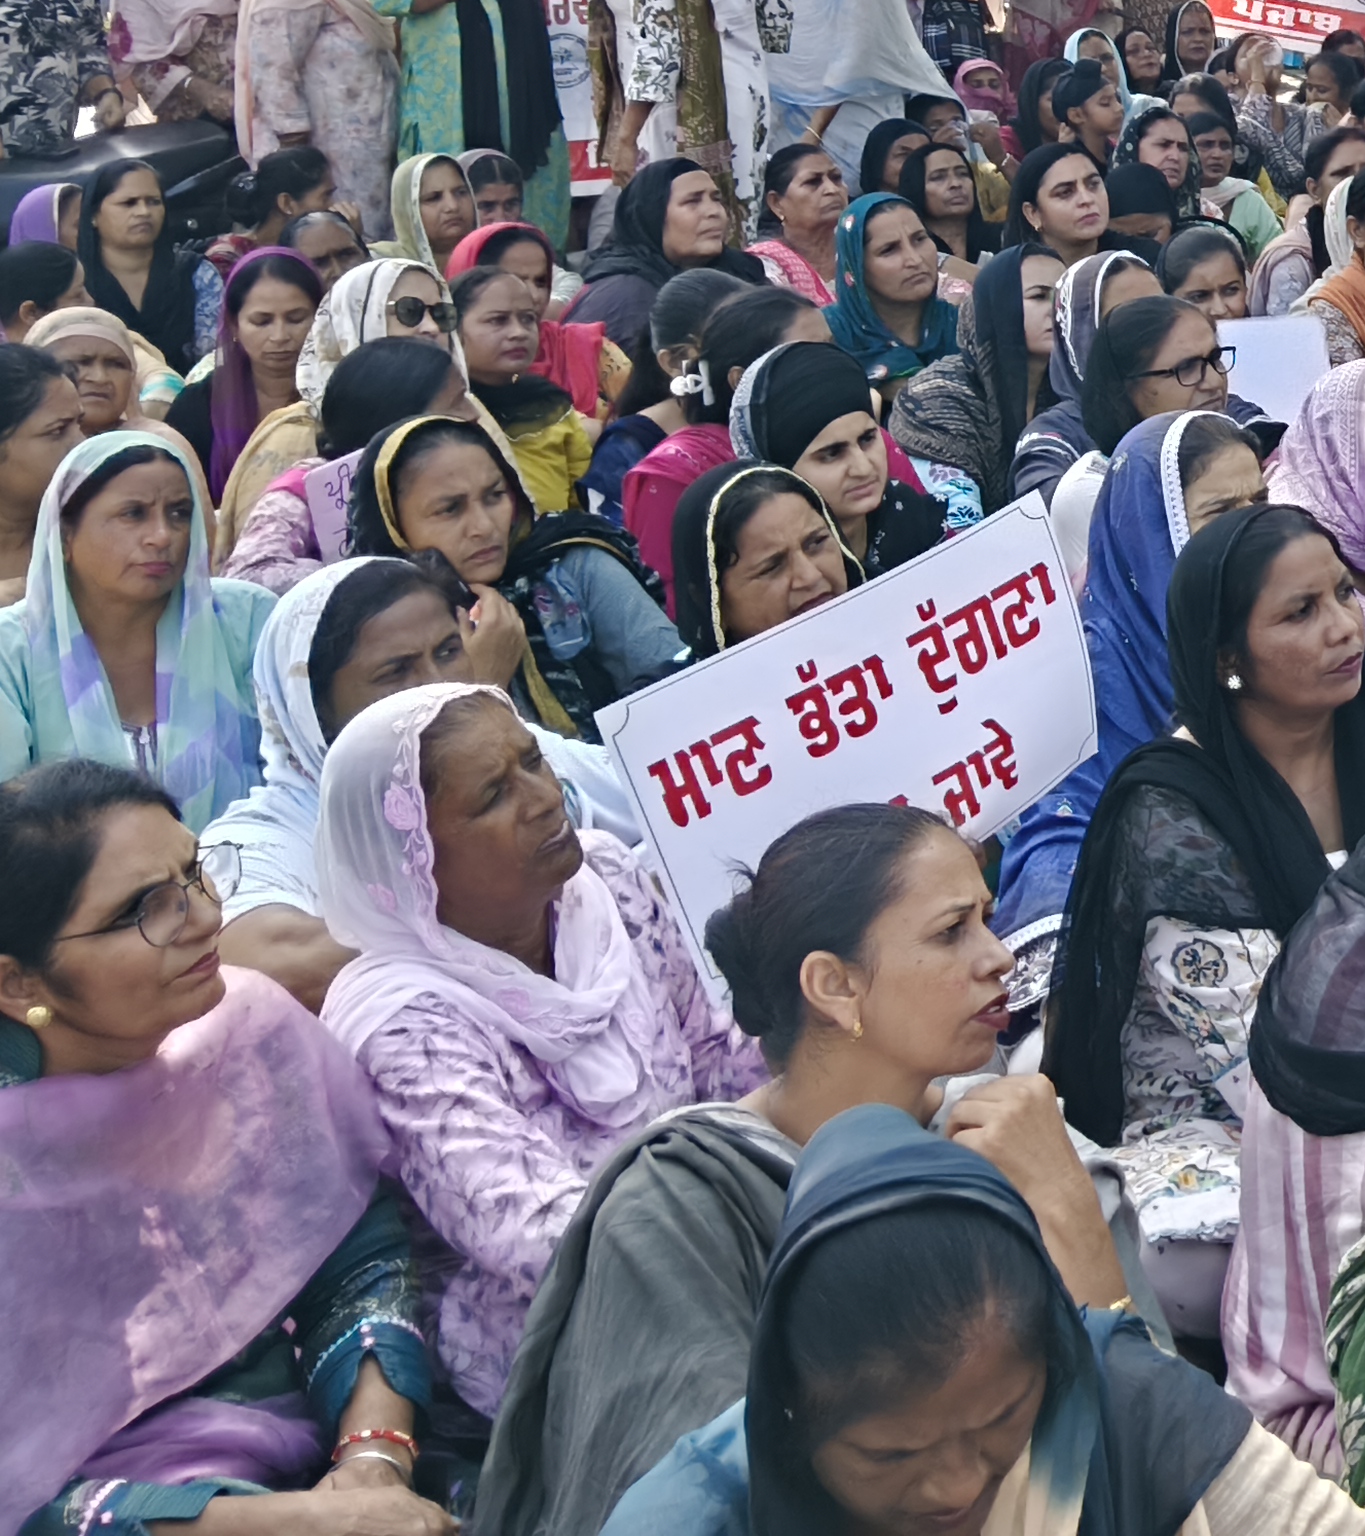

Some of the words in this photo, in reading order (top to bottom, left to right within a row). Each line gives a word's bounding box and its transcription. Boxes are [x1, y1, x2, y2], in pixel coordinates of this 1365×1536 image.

[648, 715, 773, 828] ਮਾਣ
[785, 654, 894, 758] ਭੱਤਾ
[931, 718, 1019, 827] ਜਾਵੇ
